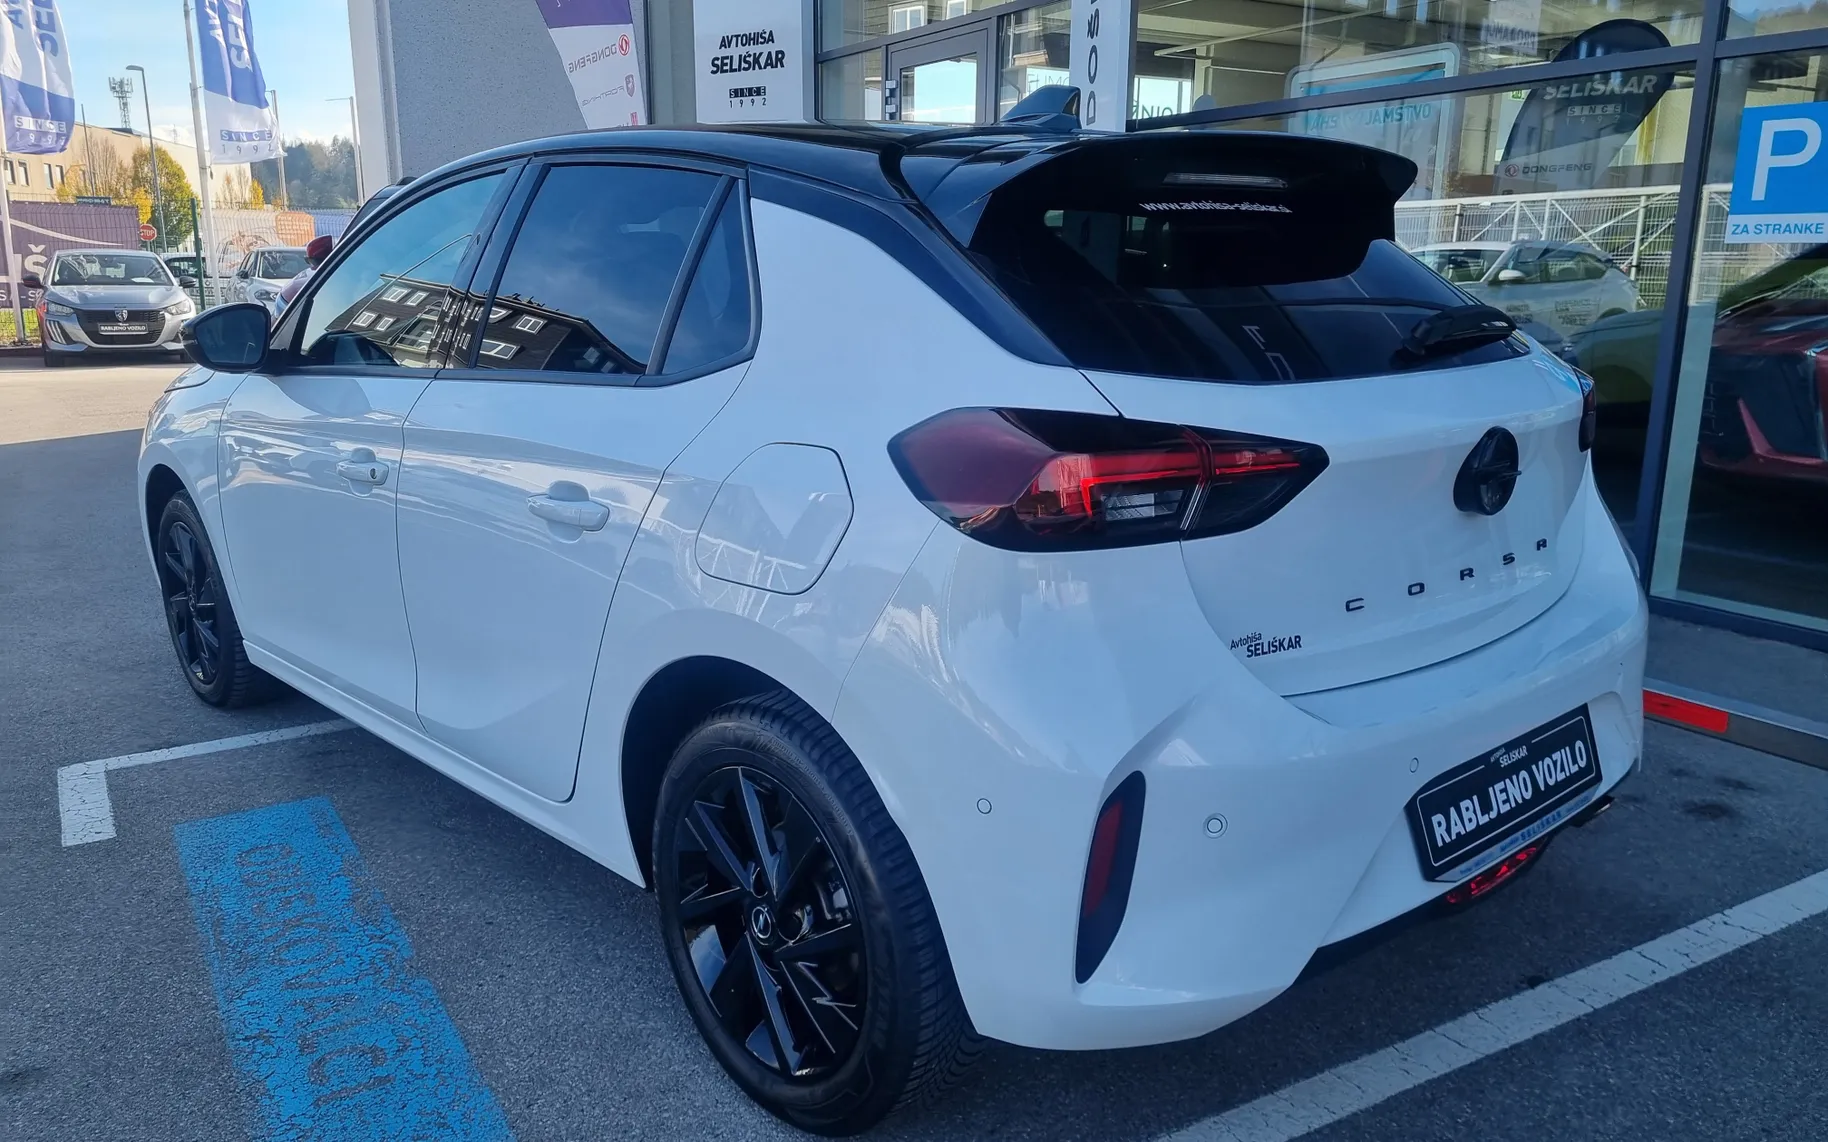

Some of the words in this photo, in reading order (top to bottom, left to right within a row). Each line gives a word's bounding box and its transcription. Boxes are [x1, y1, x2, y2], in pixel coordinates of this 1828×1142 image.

[719, 29, 775, 50] AVTOHIŠA
[710, 50, 786, 75] SELIŠKAR
[1086, 0, 1100, 126] DOŠ
[729, 86, 766, 98] SINCE
[729, 98, 767, 108] 1992
[1569, 105, 1621, 115] SINCE
[1365, 103, 1432, 125] JAMSTVO
[16, 116, 66, 132] SINCE
[221, 130, 272, 141] SINCE
[1522, 163, 1593, 174] DONGFENG
[1751, 117, 1822, 201] P
[1731, 224, 1750, 236] ZA
[1753, 223, 1825, 235] STRANKE
[1230, 631, 1262, 650] Avtohiša
[1246, 636, 1302, 658] SELIŠKAR
[1431, 770, 1532, 848] RABLJENO
[1531, 740, 1587, 791] VOZILO
